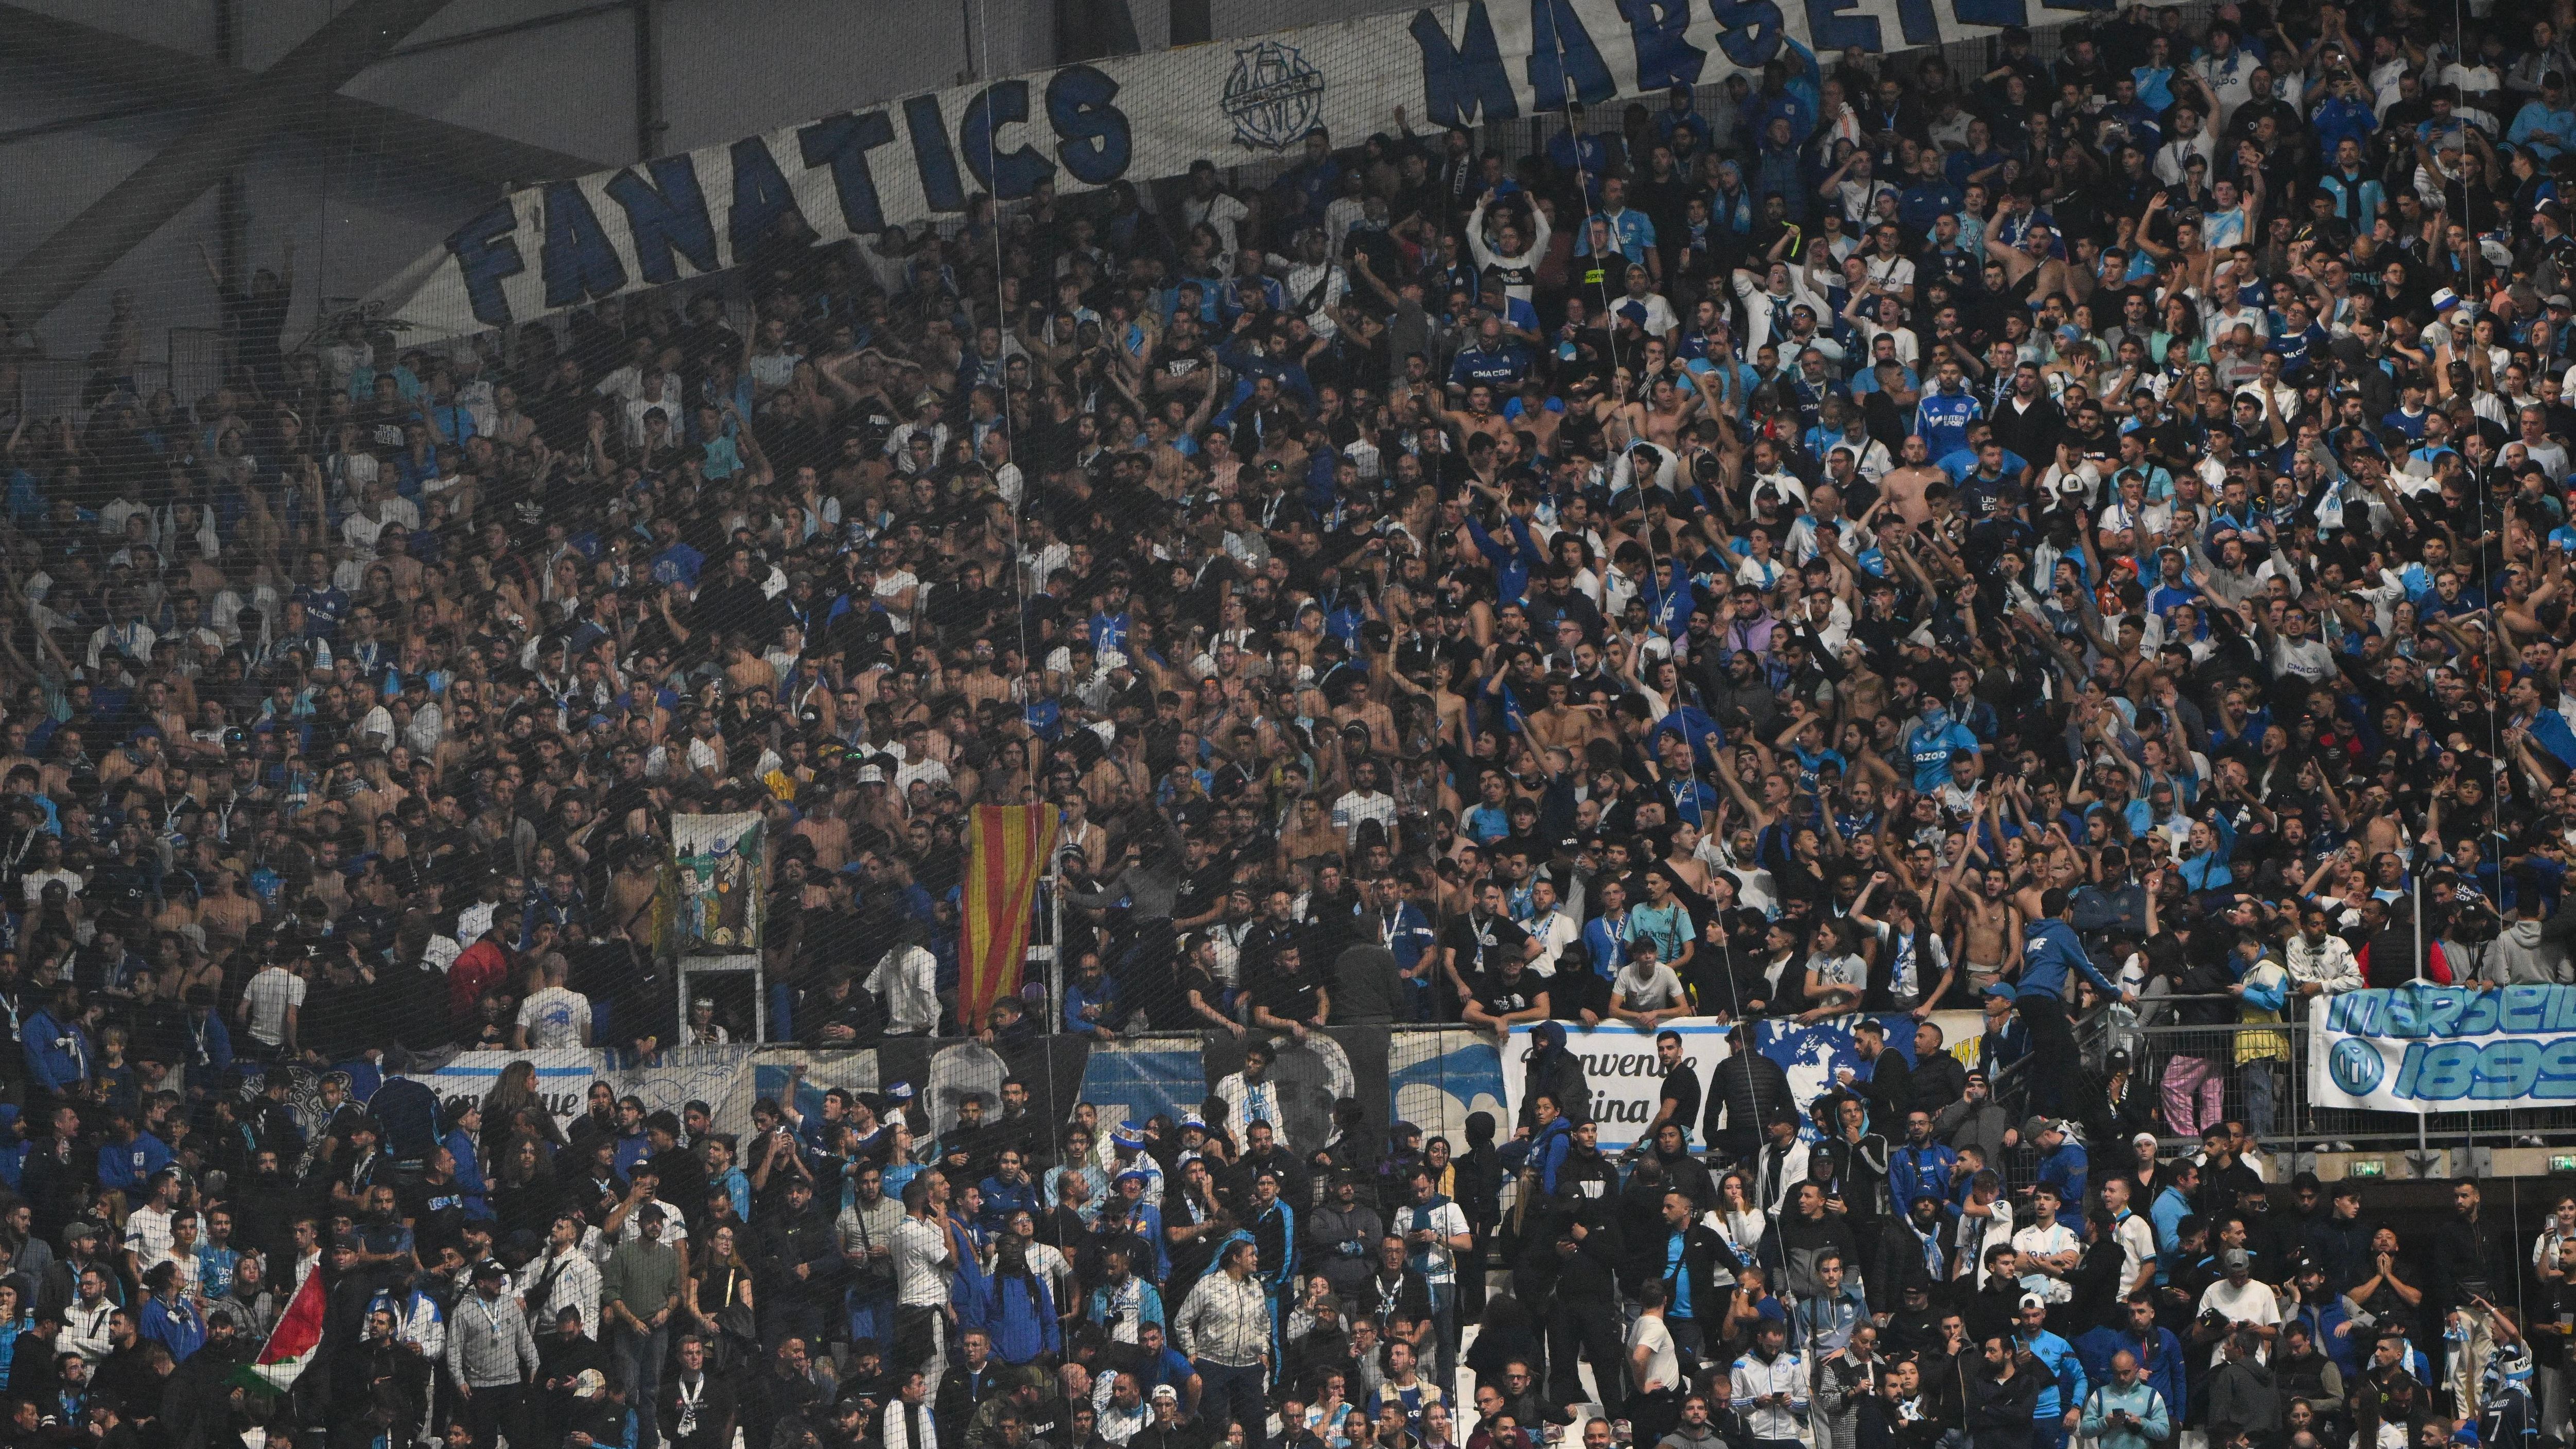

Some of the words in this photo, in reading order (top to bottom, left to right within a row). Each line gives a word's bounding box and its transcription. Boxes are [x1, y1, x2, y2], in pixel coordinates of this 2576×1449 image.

[445, 64, 1132, 326] FANATICS
[2287, 662, 2305, 672] CMA
[2457, 882, 2479, 898] Uber
[2392, 1036, 2576, 1101] 1899
[2488, 1410, 2502, 1442] 7
